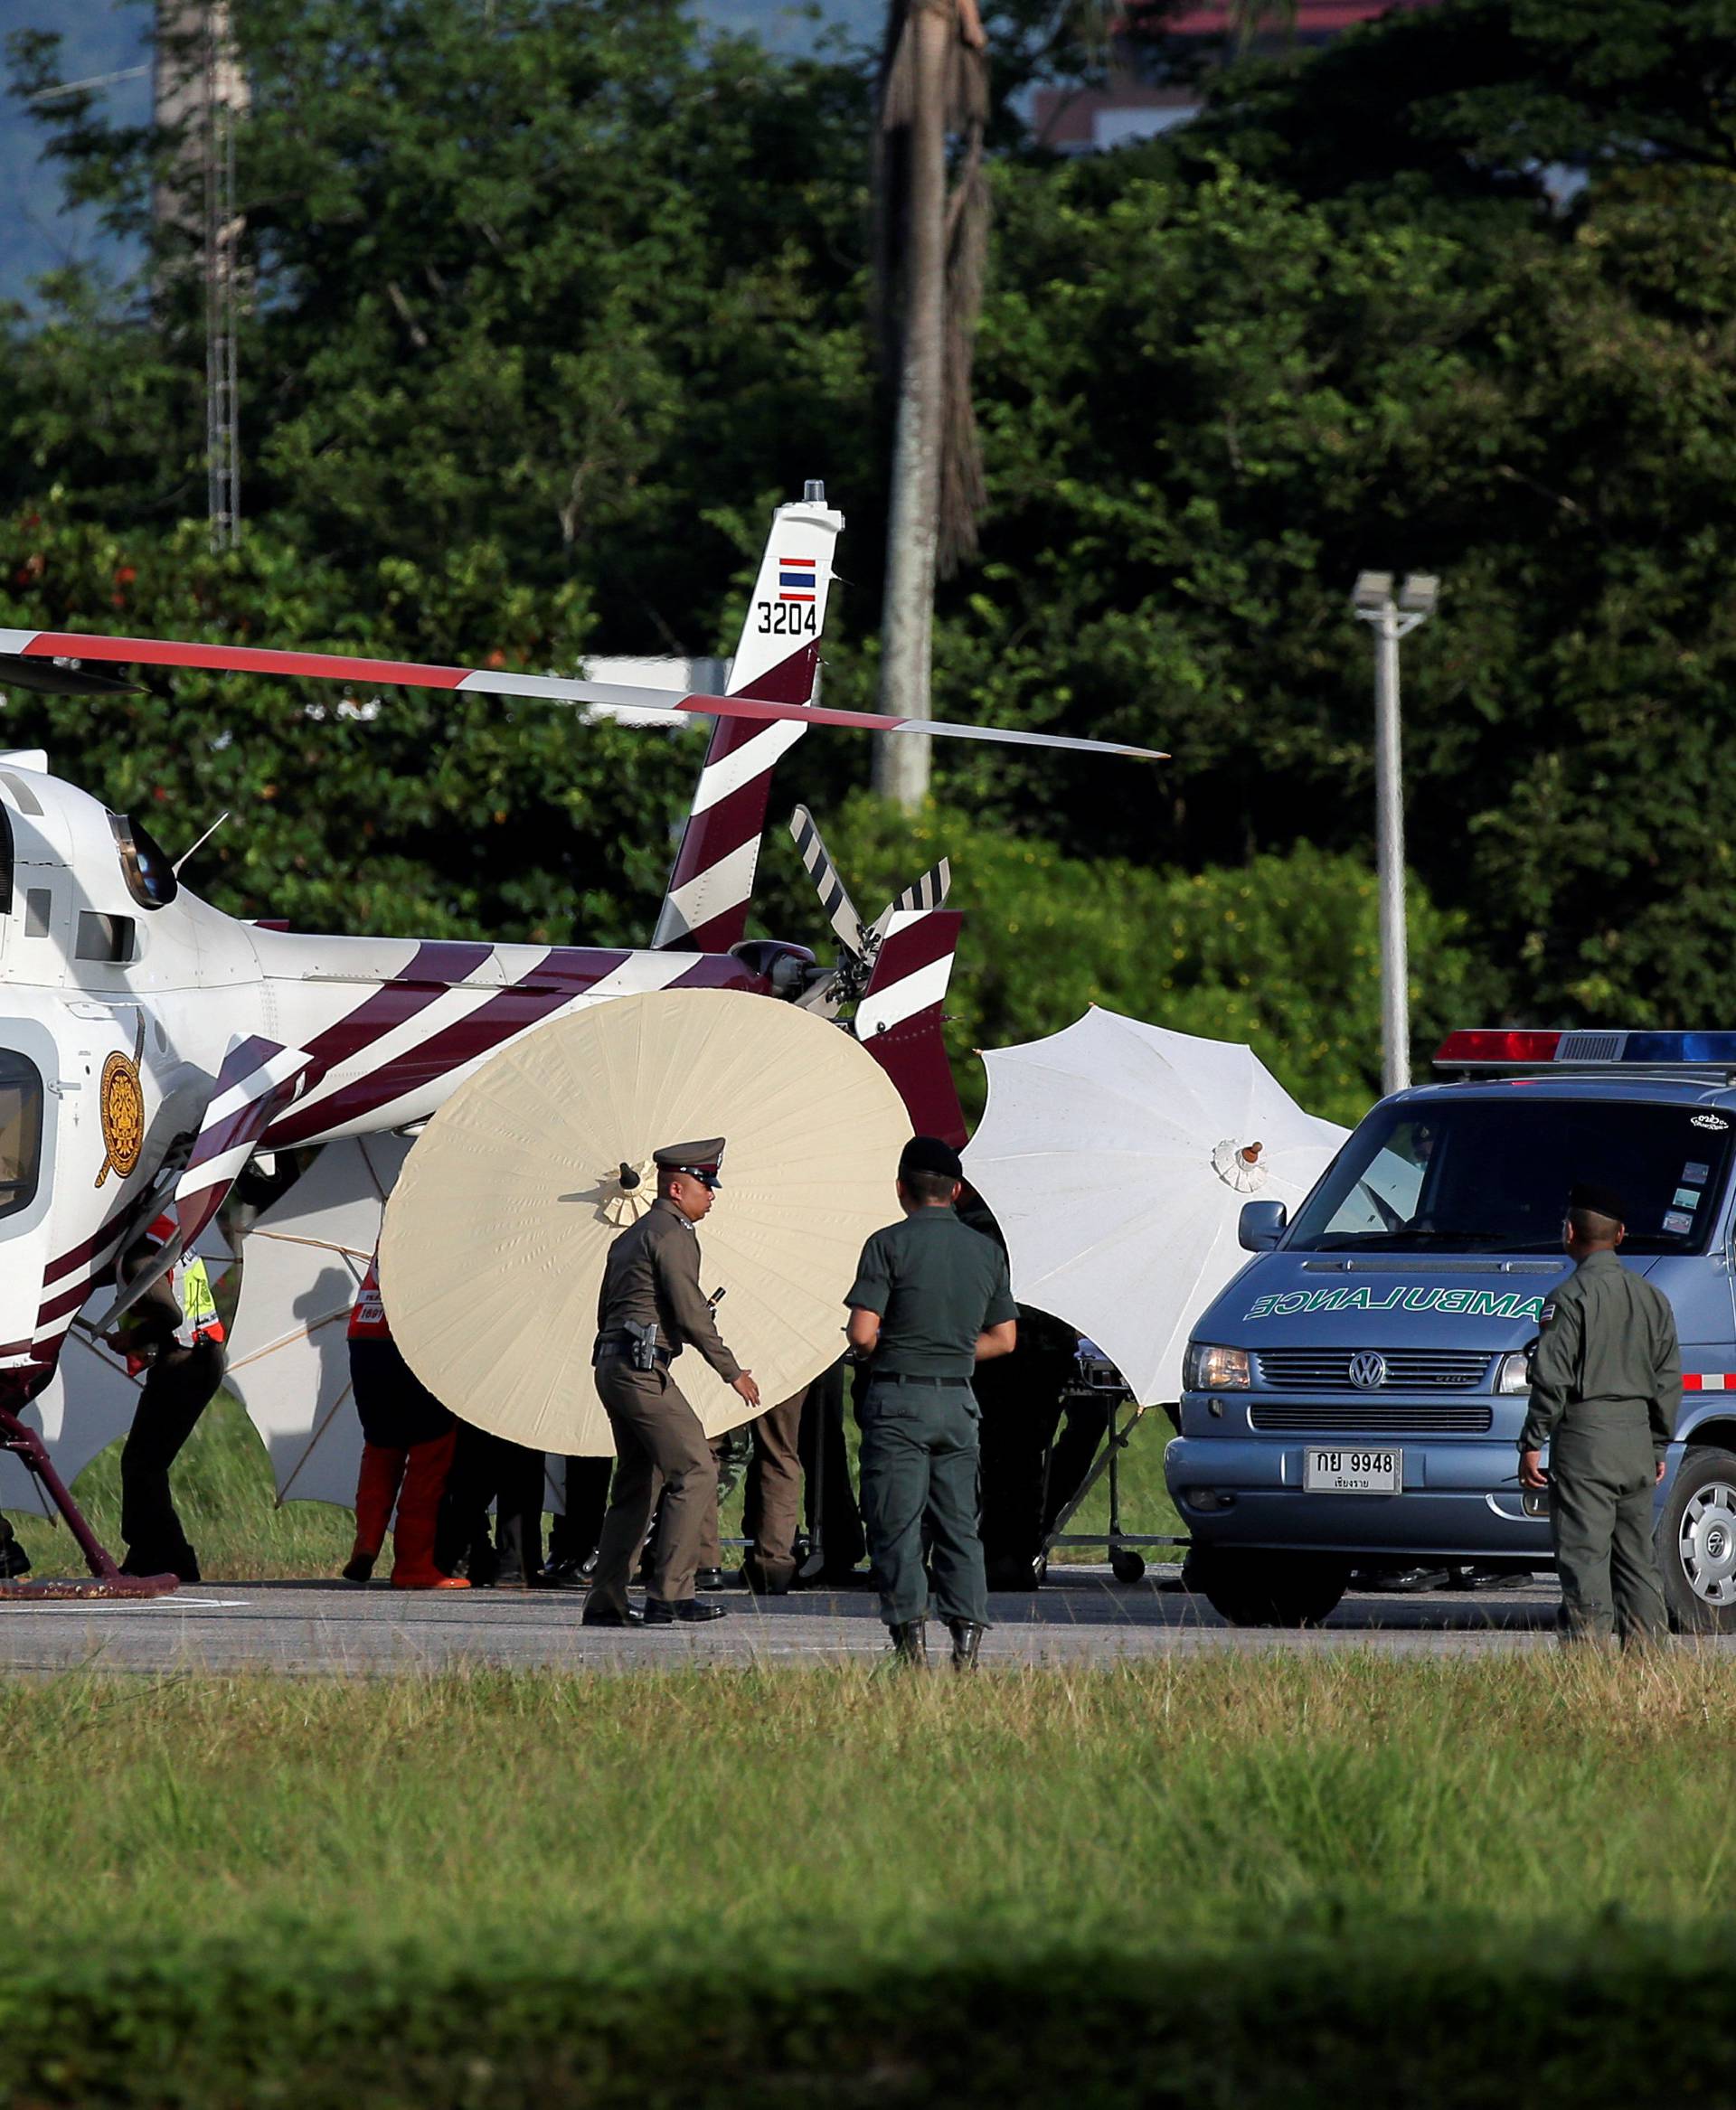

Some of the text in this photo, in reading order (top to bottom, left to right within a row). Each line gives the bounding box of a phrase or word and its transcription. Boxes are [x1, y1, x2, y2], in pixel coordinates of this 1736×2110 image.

[758, 601, 816, 636] 3204
[1317, 1453, 1393, 1473] กย 9948
